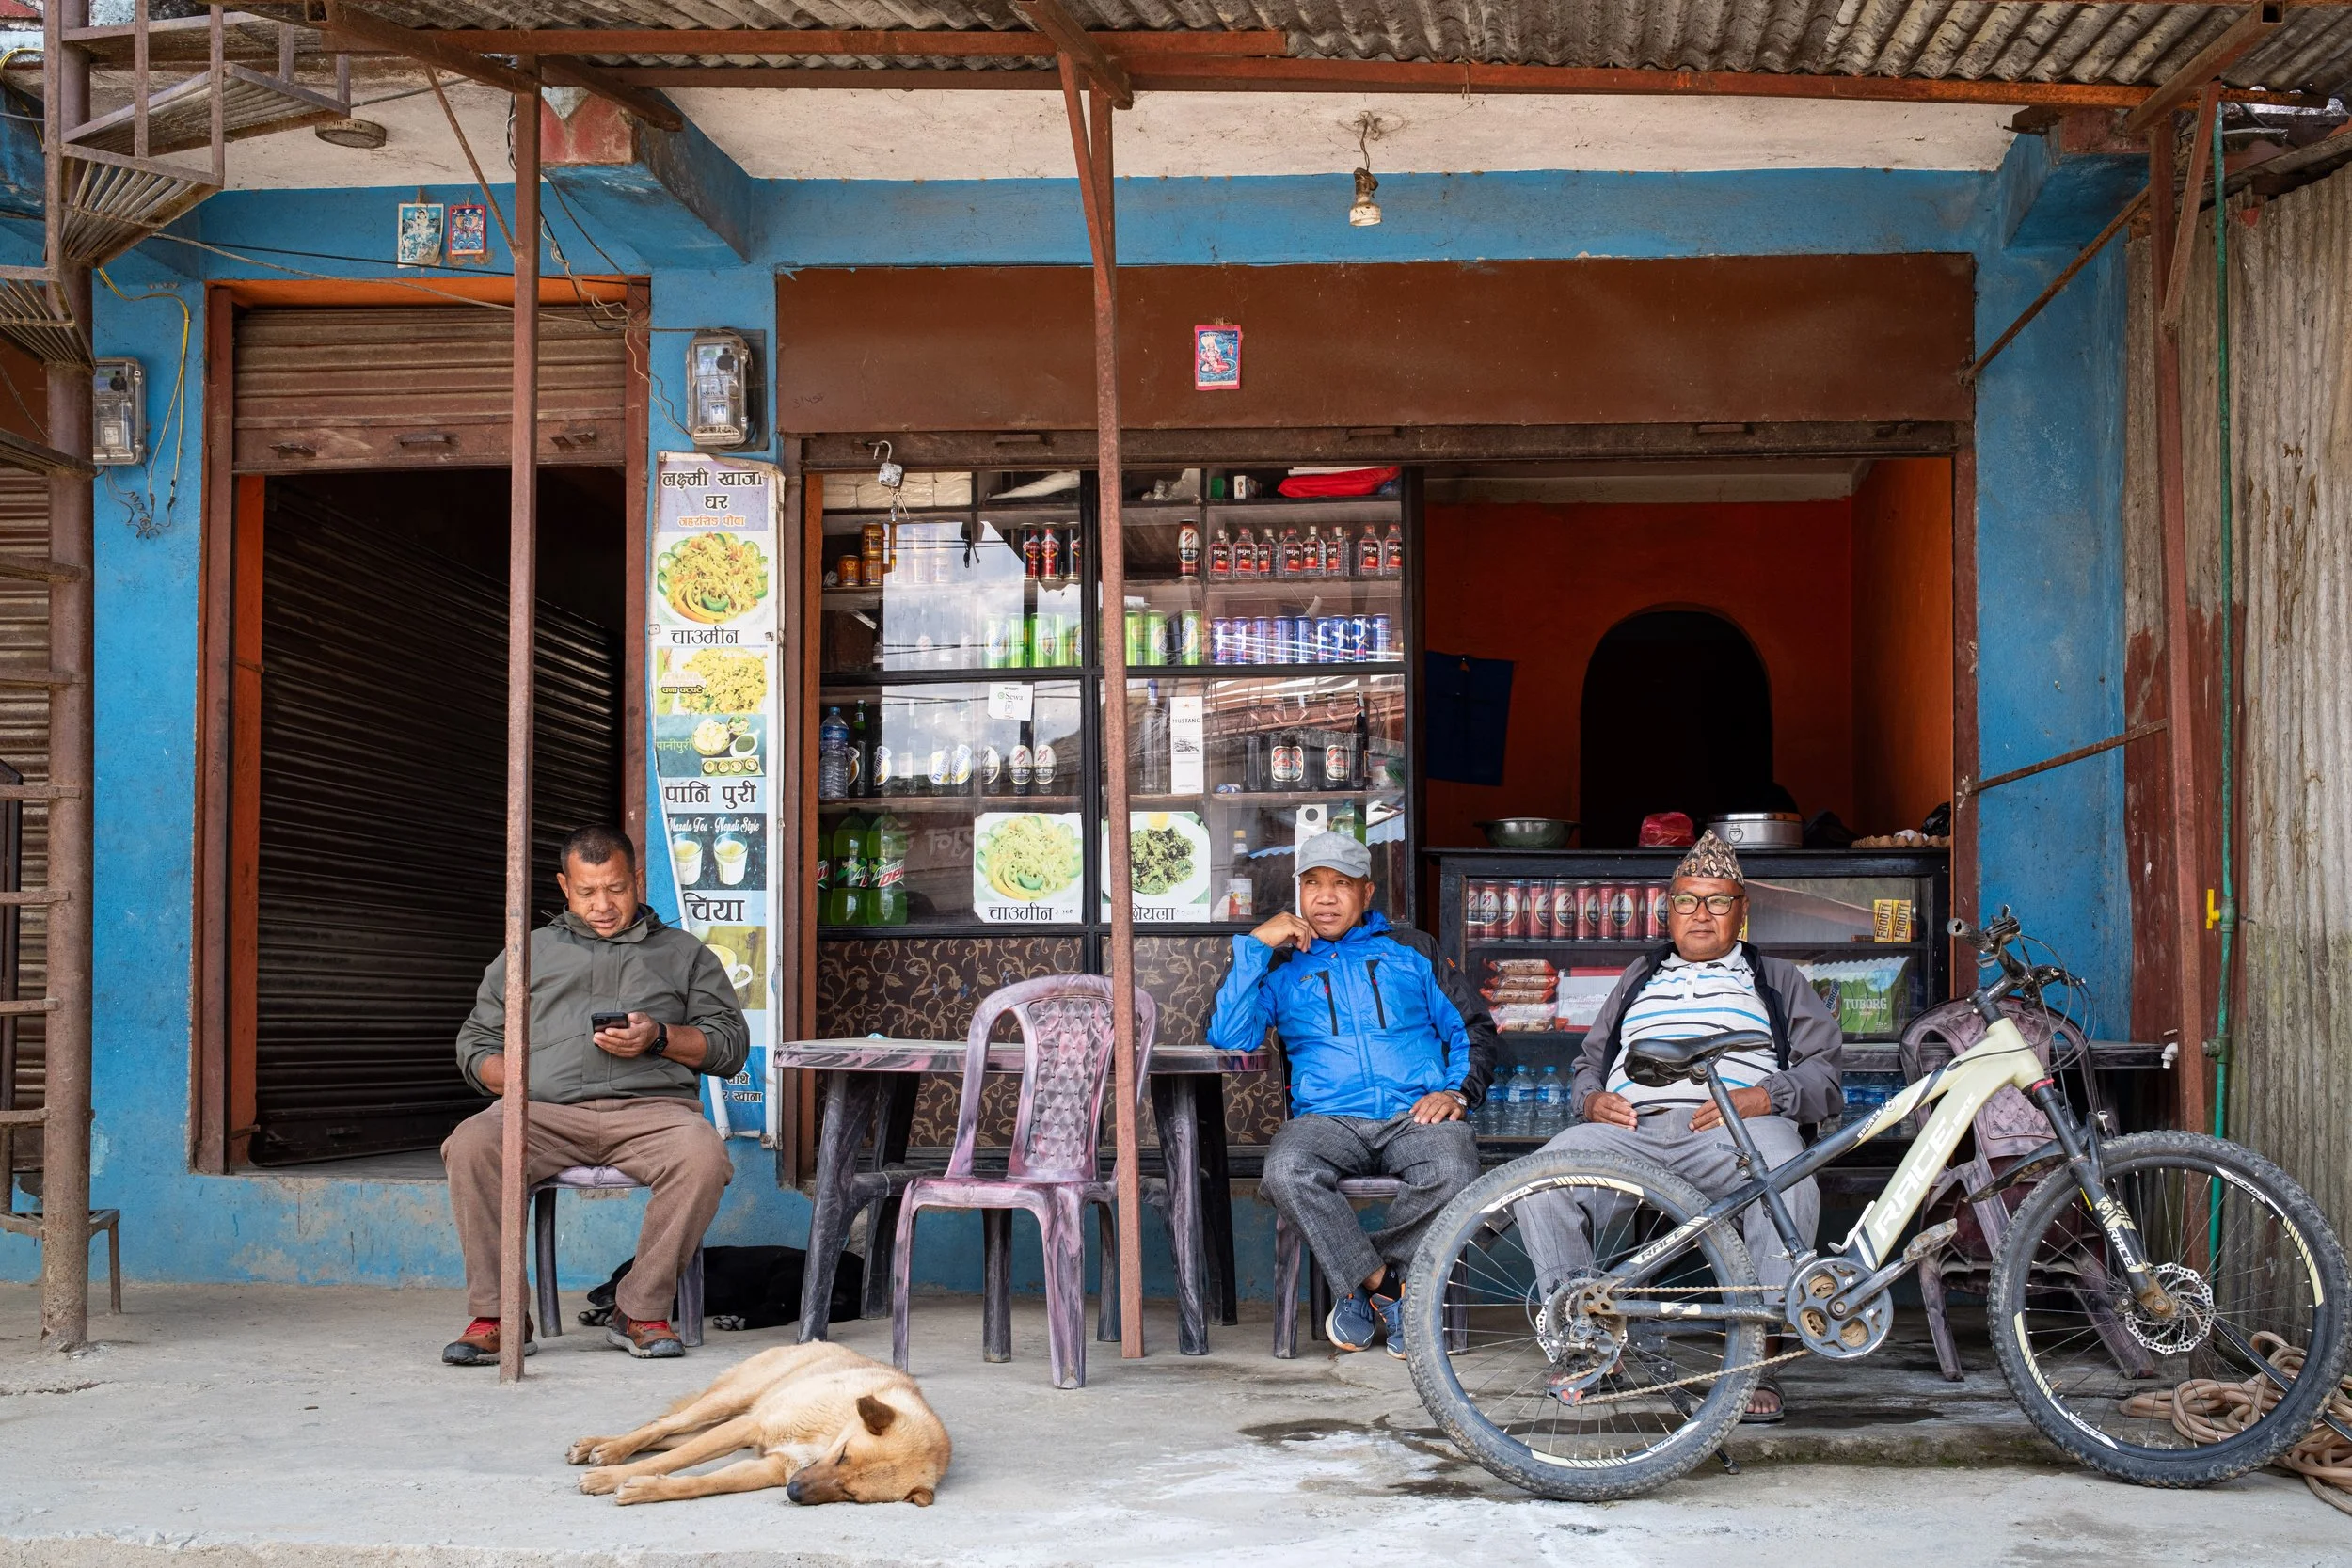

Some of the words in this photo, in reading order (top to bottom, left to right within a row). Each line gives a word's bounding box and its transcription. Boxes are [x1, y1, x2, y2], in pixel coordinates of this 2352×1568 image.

[662, 467, 709, 489] लक्ष्मी
[718, 471, 763, 486] खाजा
[705, 495, 729, 509] घर
[671, 625, 739, 645] चाउमीन
[665, 781, 711, 803] पानि
[722, 780, 757, 809] पुरी
[693, 816, 708, 832] Tea
[715, 816, 739, 833] Nepali
[740, 816, 760, 835] Style
[683, 892, 745, 922] चिया
[988, 902, 1054, 920] चाउमीन
[1844, 997, 1887, 1010] TUBORG
[734, 1091, 763, 1101] खाना
[1857, 1109, 1882, 1139] SPORTS
[1873, 1116, 1954, 1241] RACE
[1641, 1227, 1687, 1261] RACE
[2107, 1227, 2137, 1268] RACE
